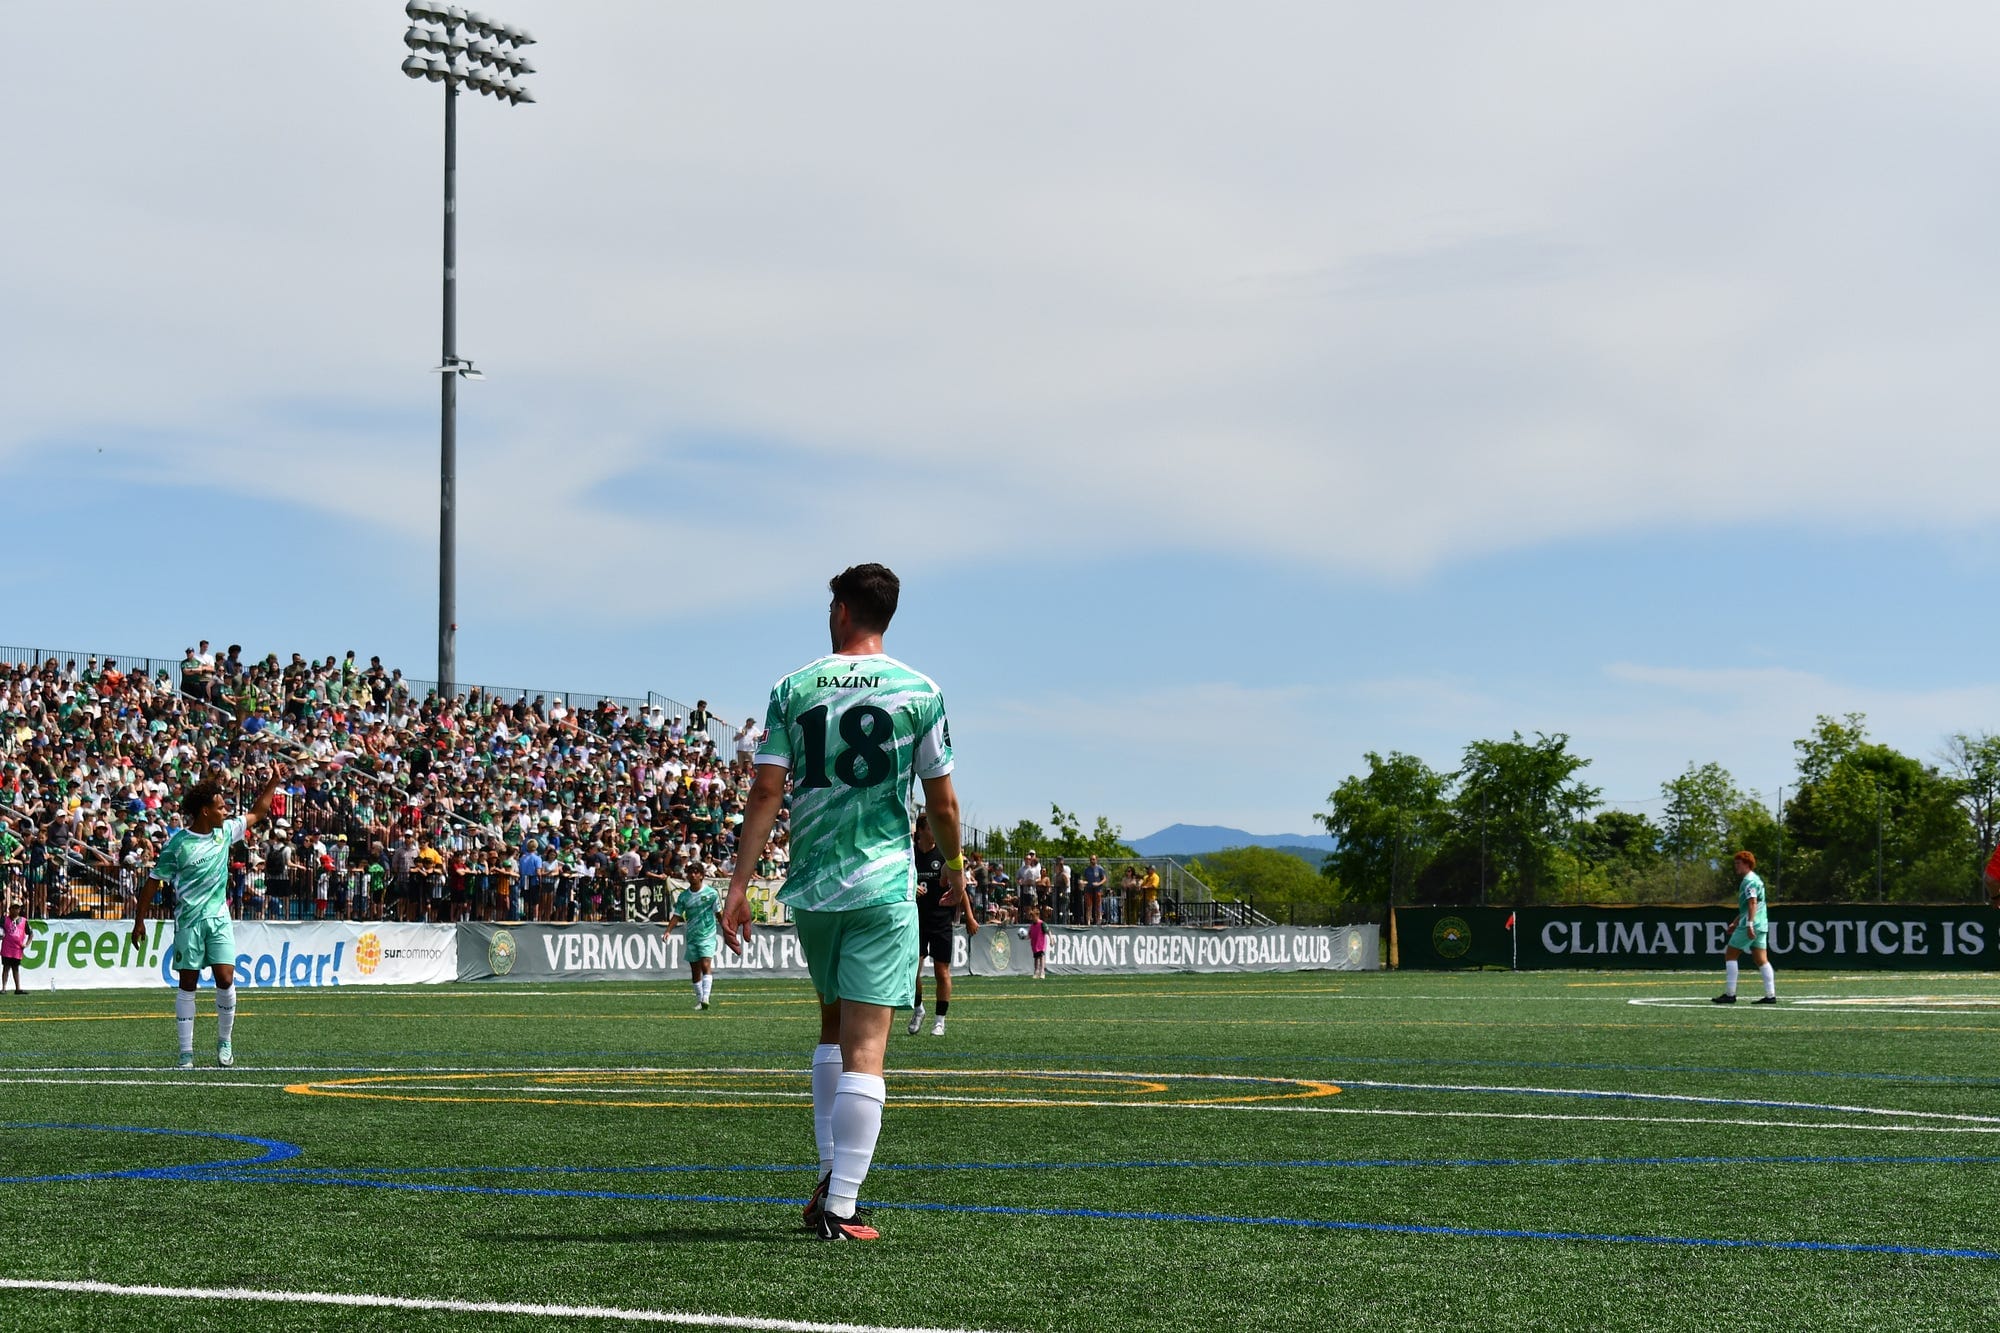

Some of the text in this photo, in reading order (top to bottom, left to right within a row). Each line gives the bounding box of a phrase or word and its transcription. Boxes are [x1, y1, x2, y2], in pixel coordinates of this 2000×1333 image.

[816, 676, 880, 688] BAZINI
[796, 705, 893, 788] 18
[20, 919, 165, 969] Green!
[384, 948, 442, 960] suncommon
[543, 933, 684, 970] VERMONT
[713, 934, 774, 969] REEN
[1045, 935, 1129, 965] ERMONT
[1134, 935, 1195, 965] GREEN
[1198, 935, 1290, 965] FOOTBALL
[1293, 935, 1331, 963] CLUB
[1541, 921, 1729, 954] CLIMATE
[1768, 920, 1928, 954] USTICE
[1942, 921, 1984, 955] IS
[234, 941, 345, 987] solar!
